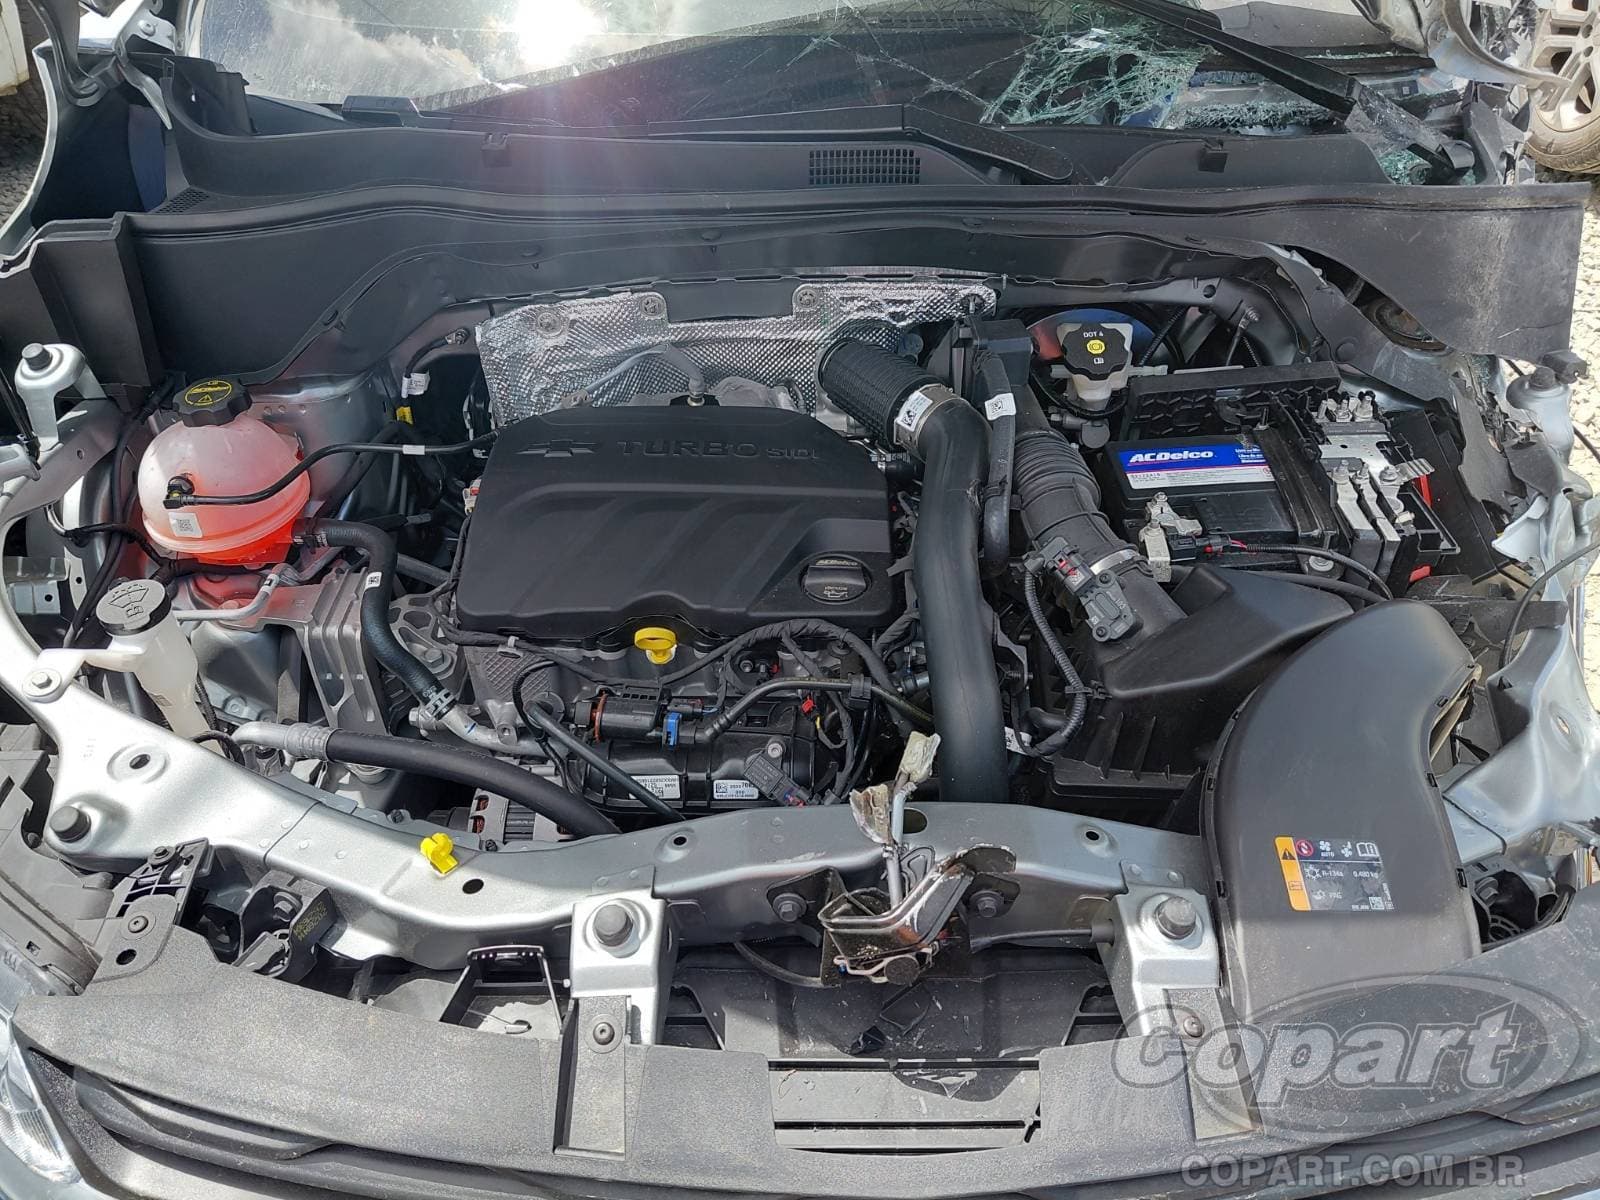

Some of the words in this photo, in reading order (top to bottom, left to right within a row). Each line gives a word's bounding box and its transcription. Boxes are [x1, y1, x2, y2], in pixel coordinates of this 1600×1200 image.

[617, 440, 760, 458] TURBO
[1129, 450, 1214, 463] ACDelco
[1321, 869, 1344, 877] R-134a
